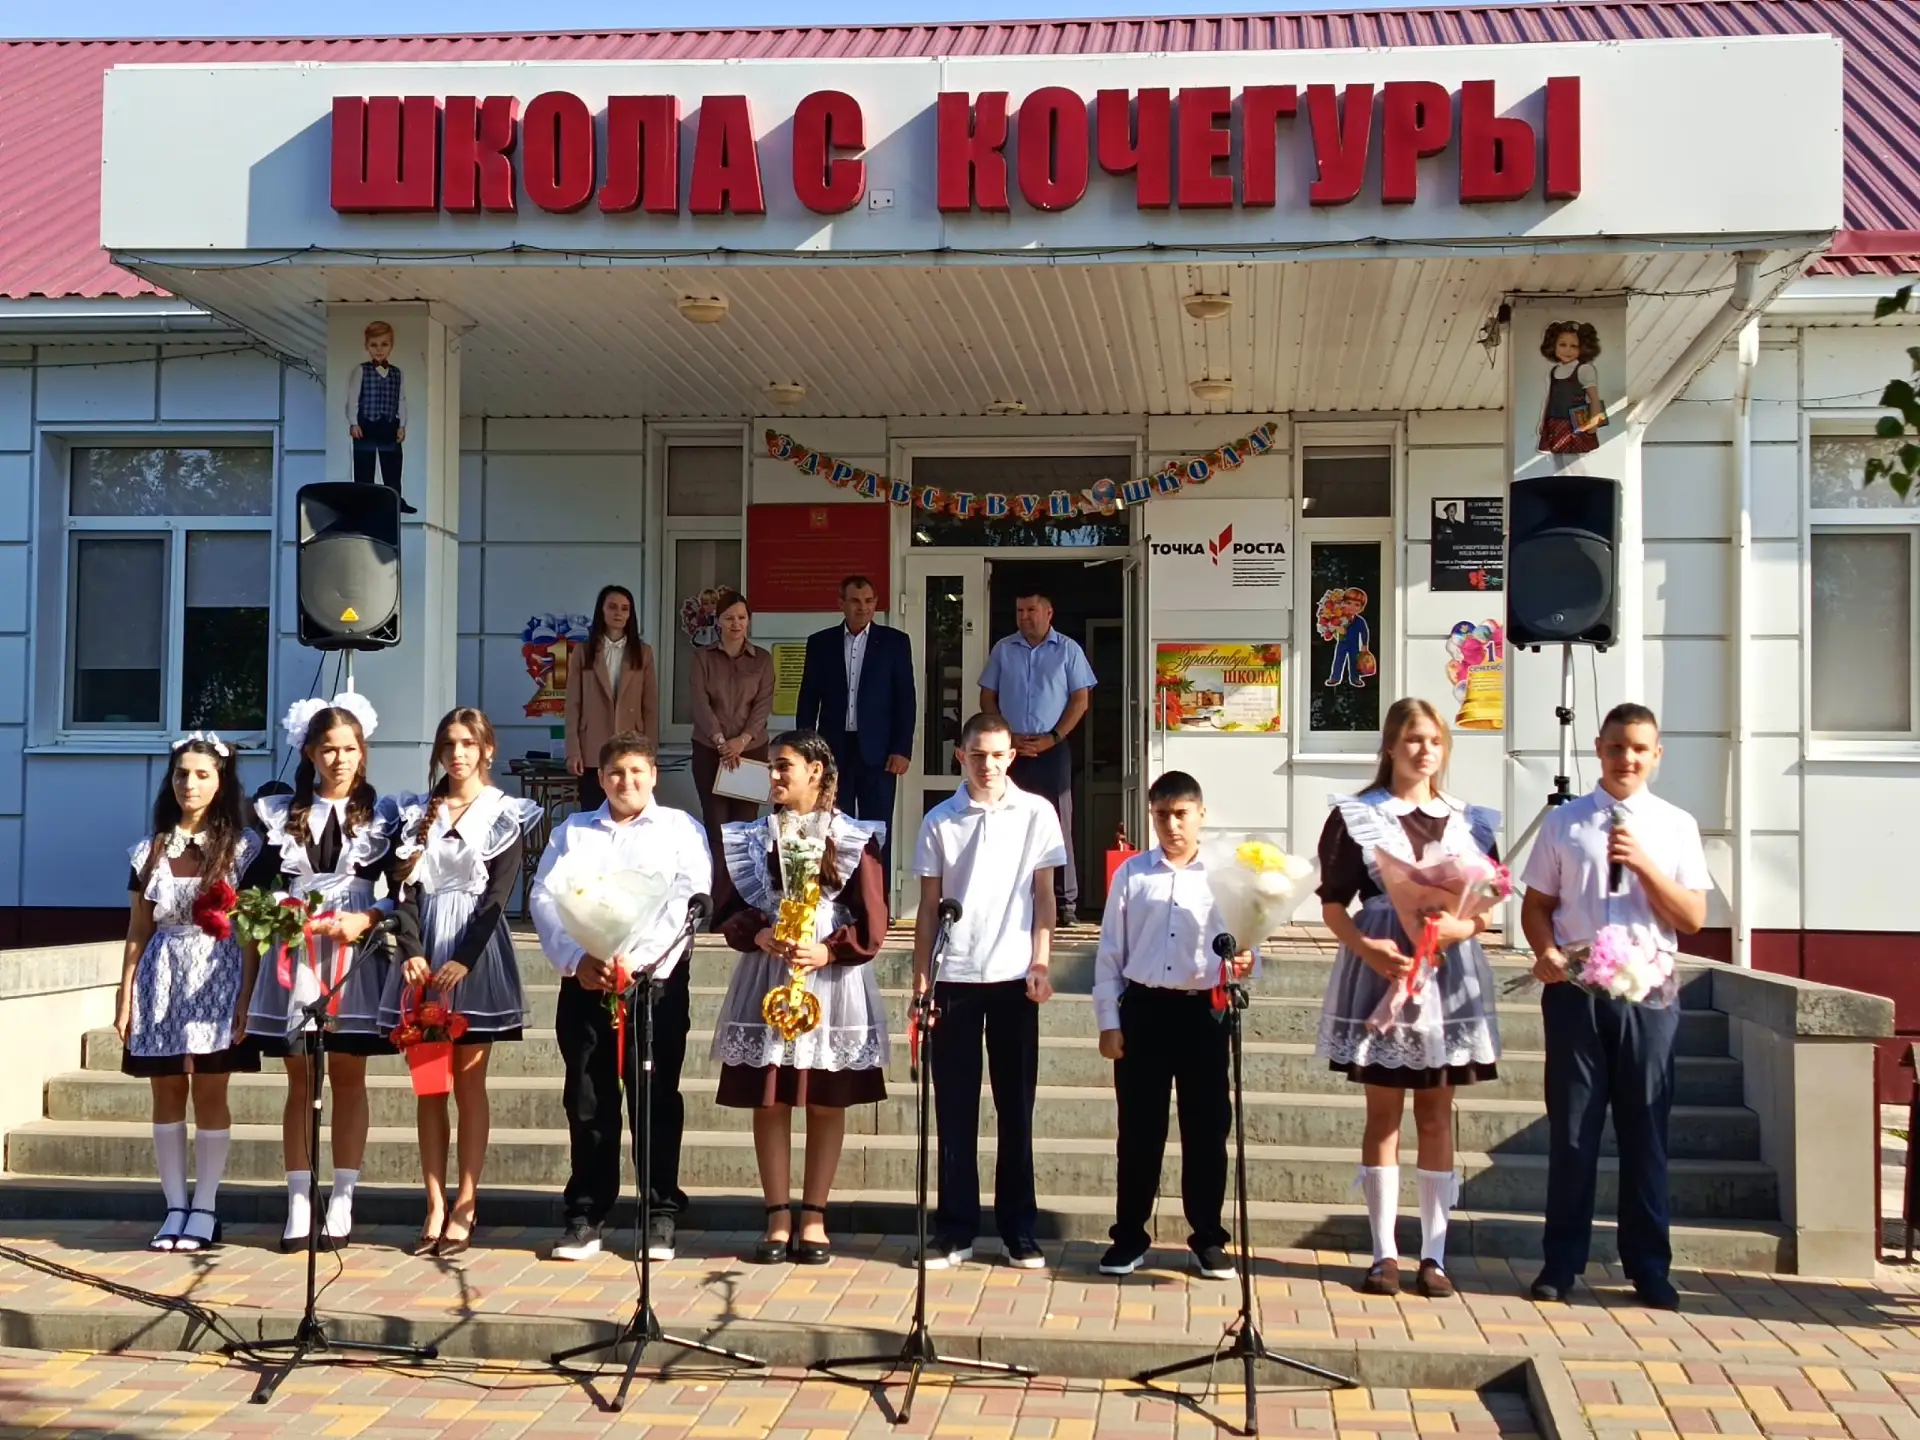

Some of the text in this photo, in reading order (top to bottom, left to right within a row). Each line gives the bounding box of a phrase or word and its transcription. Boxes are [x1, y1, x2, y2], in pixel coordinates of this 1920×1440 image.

[330, 75, 1582, 215] ШКОЛА С КОЧЕГУРЫ
[1151, 543, 1285, 555] ТОЧКА РОСТА
[1484, 640, 1495, 662] 1
[546, 638, 568, 689] 1
[1223, 669, 1279, 684] ШКОЛА!
